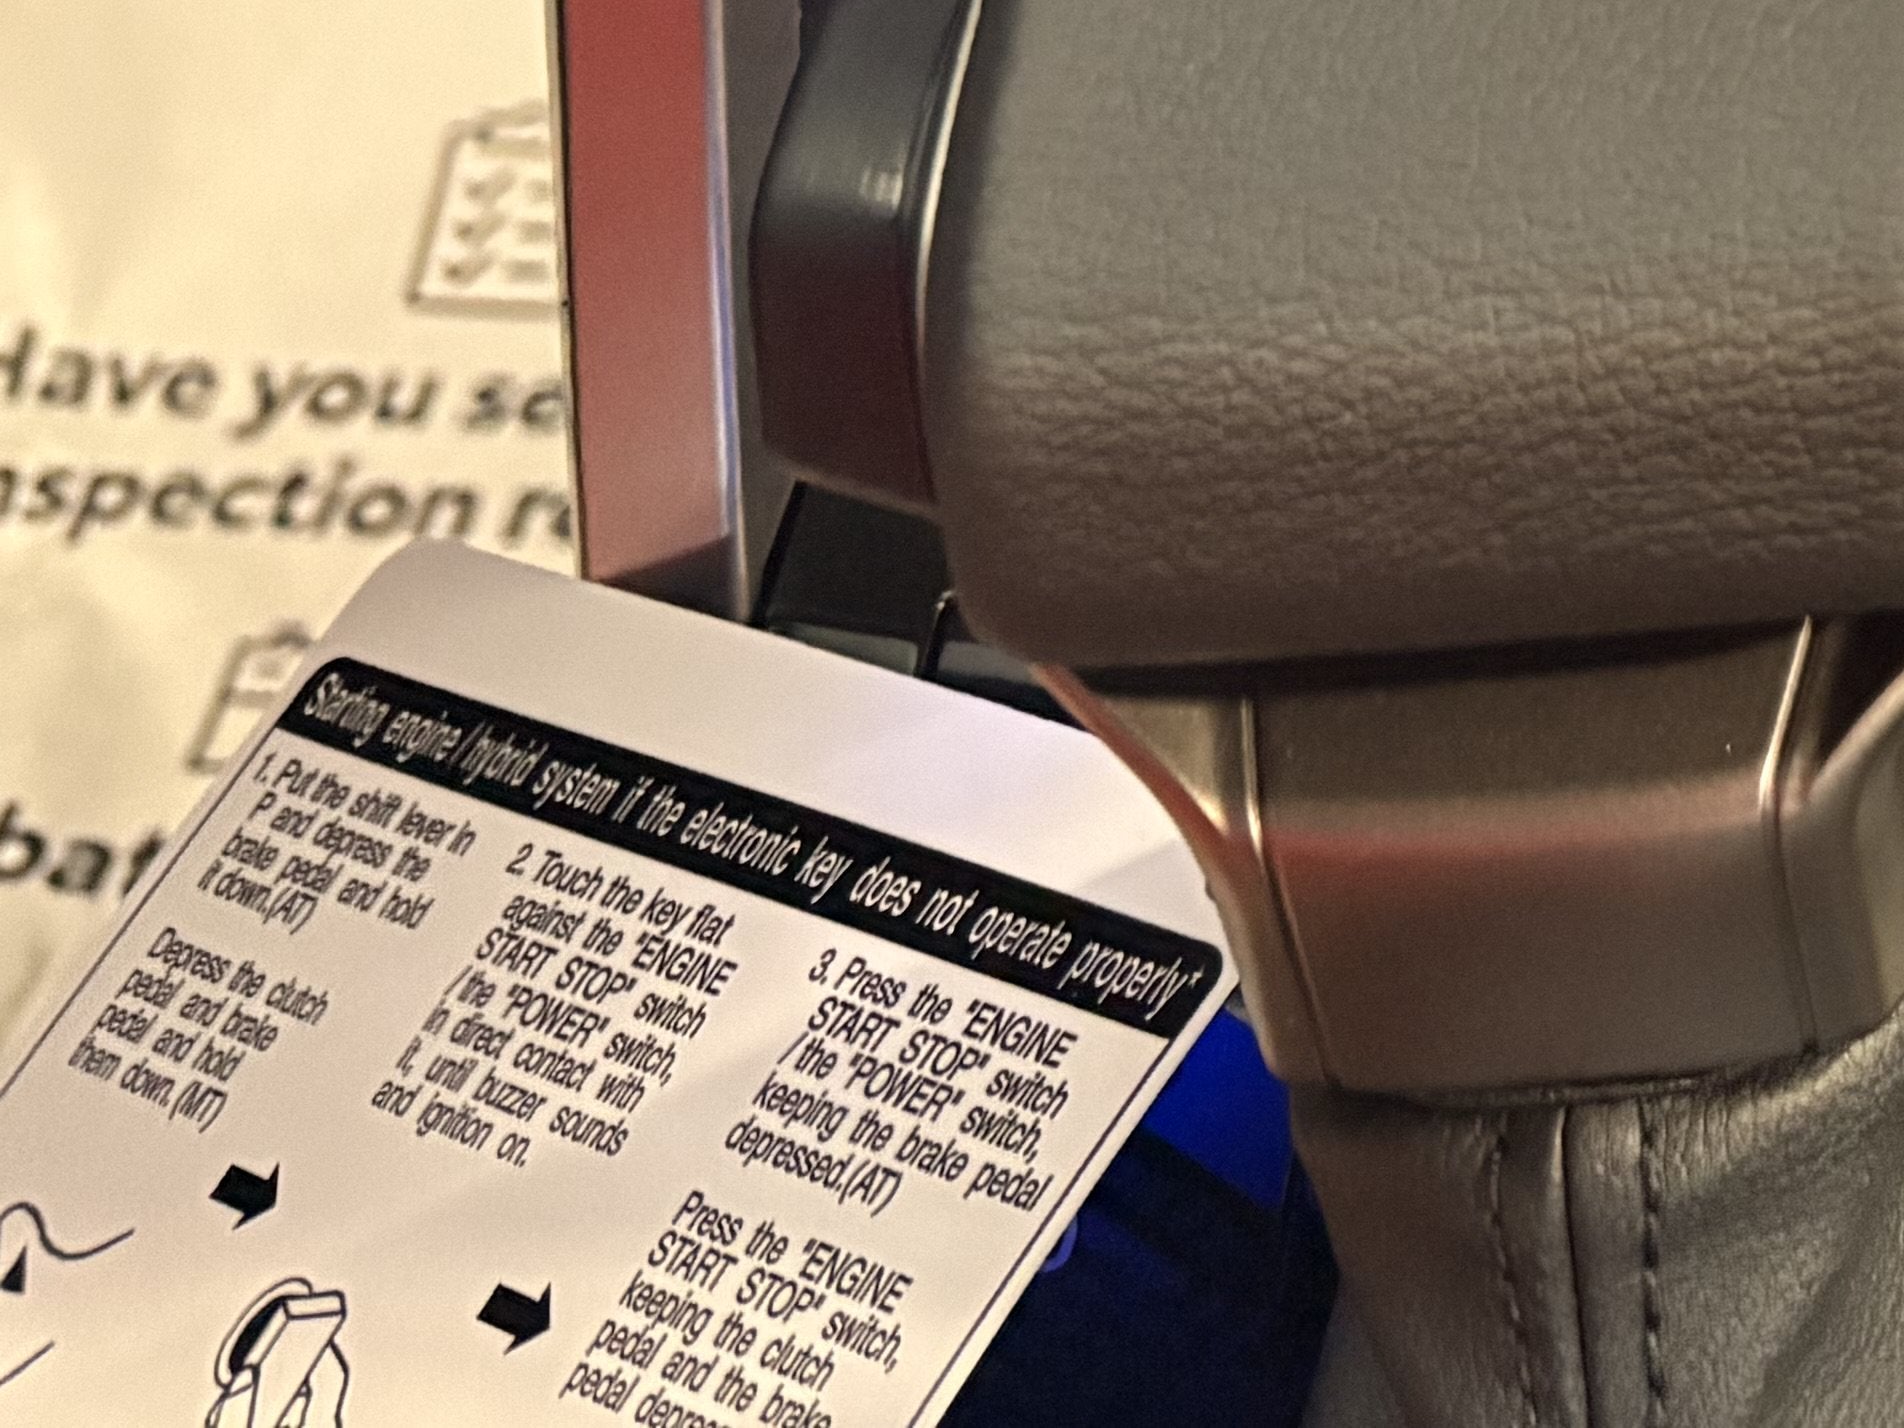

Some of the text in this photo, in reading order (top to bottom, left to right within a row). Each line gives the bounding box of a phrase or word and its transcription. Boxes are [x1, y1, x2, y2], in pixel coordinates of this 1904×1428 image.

[230, 359, 441, 442] you
[248, 791, 431, 883] P and depress the
[273, 757, 312, 797] Put
[310, 767, 351, 809] the
[347, 784, 402, 829] shift
[394, 801, 455, 848] lever
[446, 820, 478, 857] in
[304, 672, 391, 748] Starting
[532, 758, 621, 811] system
[611, 775, 648, 827] if
[638, 782, 683, 837] the
[680, 801, 802, 875] electronic
[795, 836, 854, 903] key
[850, 857, 920, 918] does
[918, 882, 981, 933] not
[968, 906, 1073, 970] operate
[221, 828, 435, 931] brake pedal and hold
[501, 894, 588, 944] against
[583, 917, 625, 957] the
[505, 842, 736, 946] 2. Touch the key flat
[115, 968, 280, 1053] pedal and brake
[147, 926, 330, 1026] Depress the clutch
[475, 926, 560, 980] START
[633, 991, 707, 1039] switch
[808, 947, 838, 985] 3.
[833, 955, 908, 1009] Press
[907, 982, 953, 1026] the
[67, 1032, 120, 1080] them
[92, 1003, 247, 1083] pedal and hold
[420, 1000, 647, 1115] in direct contact with
[603, 1028, 678, 1087] switch,
[807, 995, 902, 1054] START
[985, 1068, 1070, 1121] switch
[370, 1080, 534, 1168] and ignition on.
[425, 1052, 478, 1093] until
[472, 1066, 548, 1124] buzzer
[549, 1104, 630, 1157] sounds
[751, 1069, 1055, 1213] keeping the brake pedal
[959, 1105, 1043, 1165] switch,
[671, 1189, 744, 1247] Press
[745, 1218, 790, 1265] the
[618, 1268, 836, 1392] keeping the clutch
[647, 1229, 740, 1292] START
[821, 1310, 902, 1375] switch,
[559, 1360, 640, 1414] pedal
[586, 1317, 669, 1370] pedal
[661, 1350, 721, 1393] and
[714, 1364, 758, 1412] the
